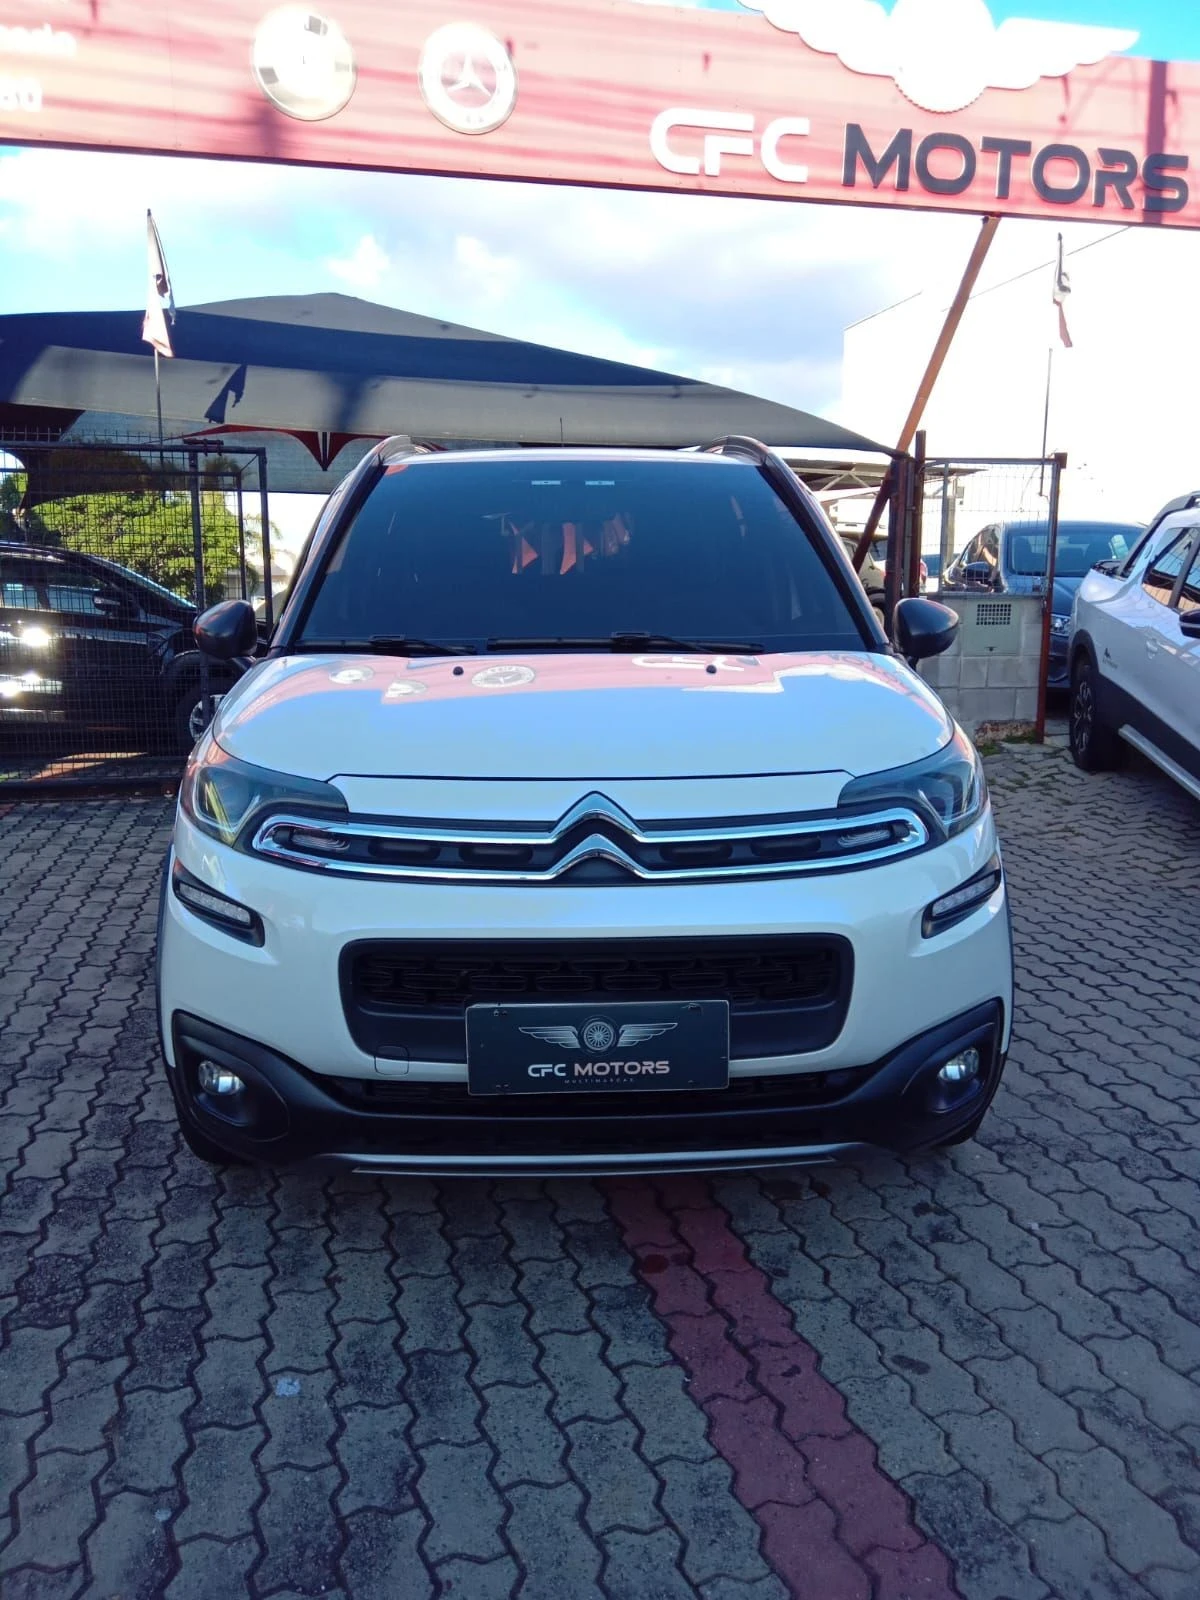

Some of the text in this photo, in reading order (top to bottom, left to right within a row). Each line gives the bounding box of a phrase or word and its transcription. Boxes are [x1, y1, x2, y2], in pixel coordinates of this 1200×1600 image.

[649, 107, 1189, 212] CFC MOTORS
[527, 1060, 670, 1077] CFC MOTORS
